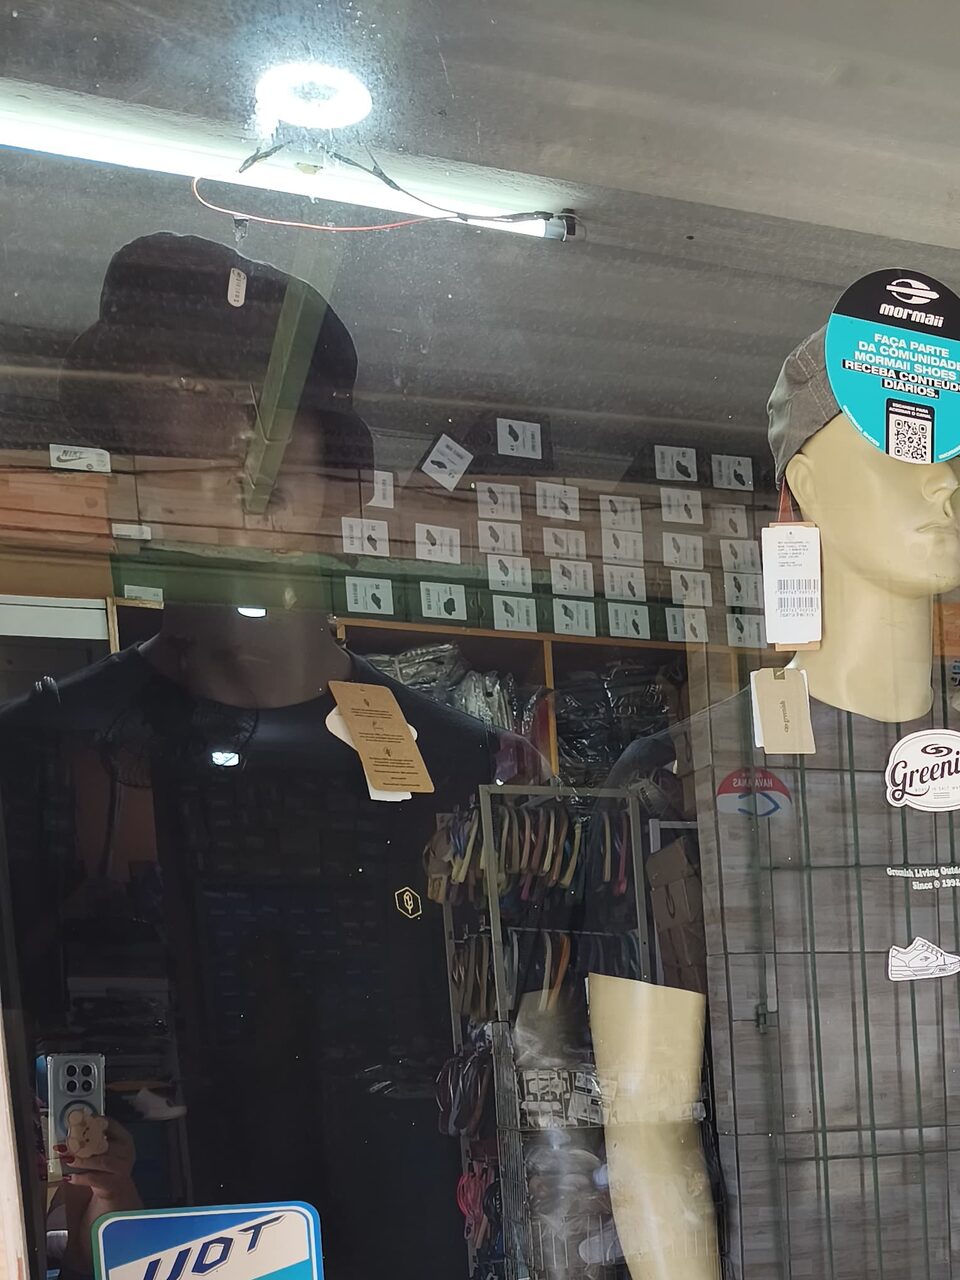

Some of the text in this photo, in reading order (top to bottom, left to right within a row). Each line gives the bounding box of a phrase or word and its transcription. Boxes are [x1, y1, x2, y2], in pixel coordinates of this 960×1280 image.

[879, 303, 944, 328] mormaii
[858, 341, 878, 353] DA
[874, 333, 949, 358] FAÇA PARTE
[844, 360, 899, 379] RECEBA
[854, 351, 910, 371] MORMAII
[913, 364, 956, 381] SHOES
[912, 881, 933, 890] Since
